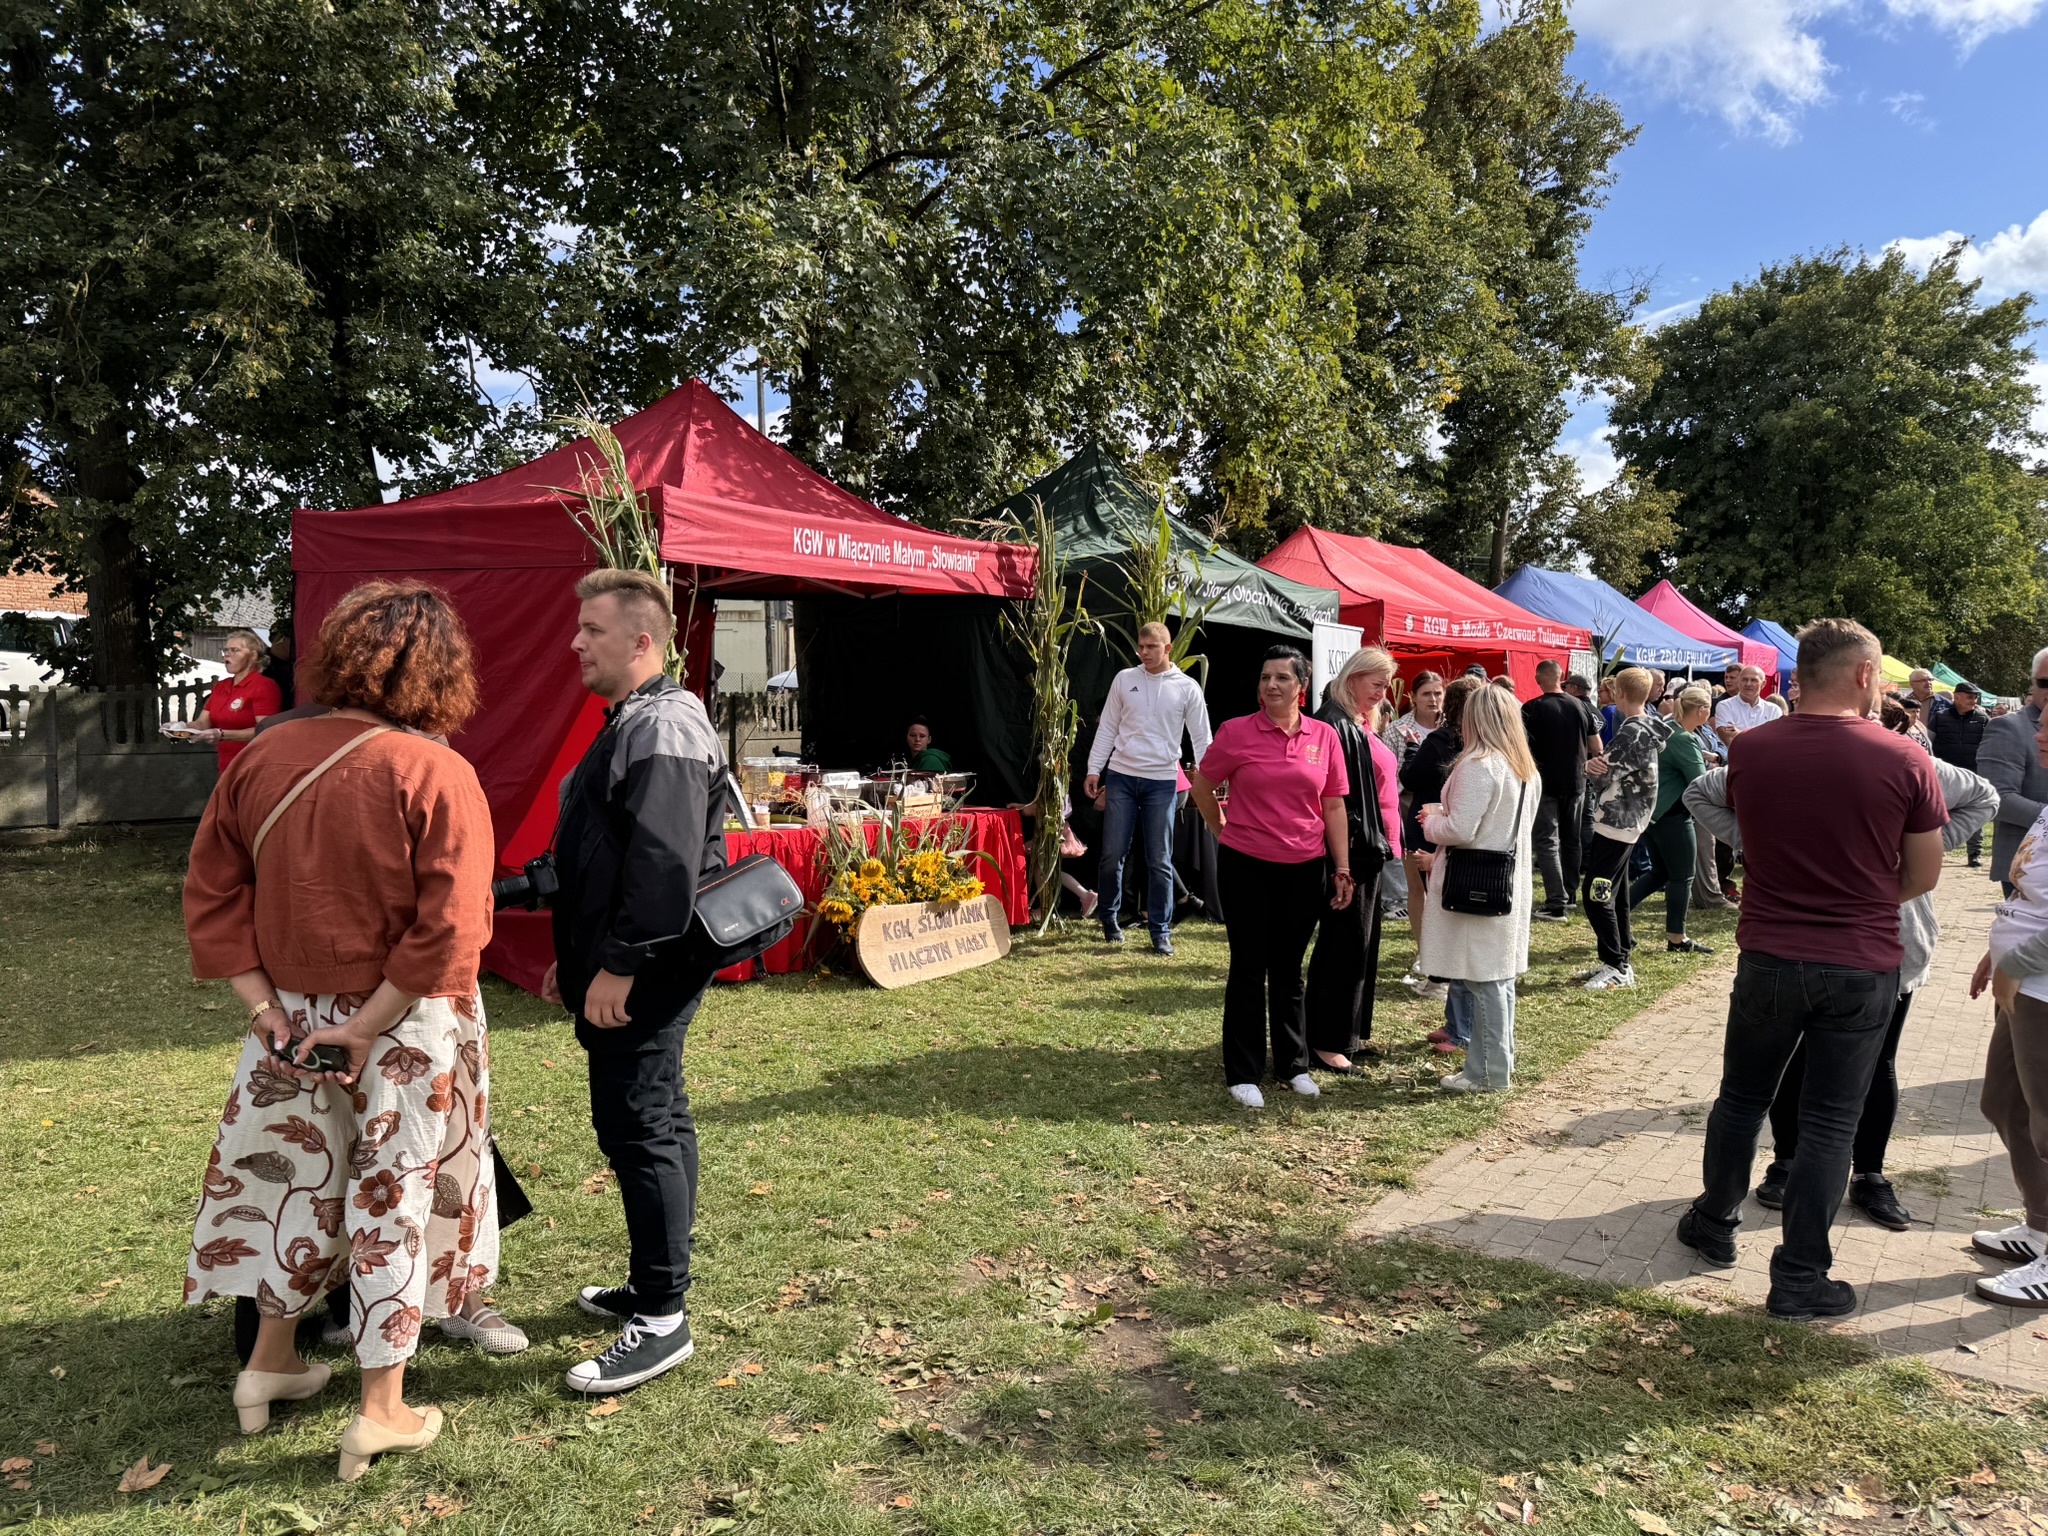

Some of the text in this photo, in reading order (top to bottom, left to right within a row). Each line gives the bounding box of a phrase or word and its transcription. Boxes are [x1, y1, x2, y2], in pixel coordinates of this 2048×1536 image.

[793, 527, 824, 556] KGW
[826, 538, 836, 557] w
[838, 533, 891, 568] Miączynie
[893, 540, 925, 572] Małym
[1423, 616, 1449, 635] KGW
[1451, 623, 1460, 636] w
[1493, 621, 1536, 642] "Czerwone
[1636, 647, 1657, 663] KGW
[882, 918, 911, 942] KGW
[888, 932, 989, 972] MIĄCZYN MAŁY
